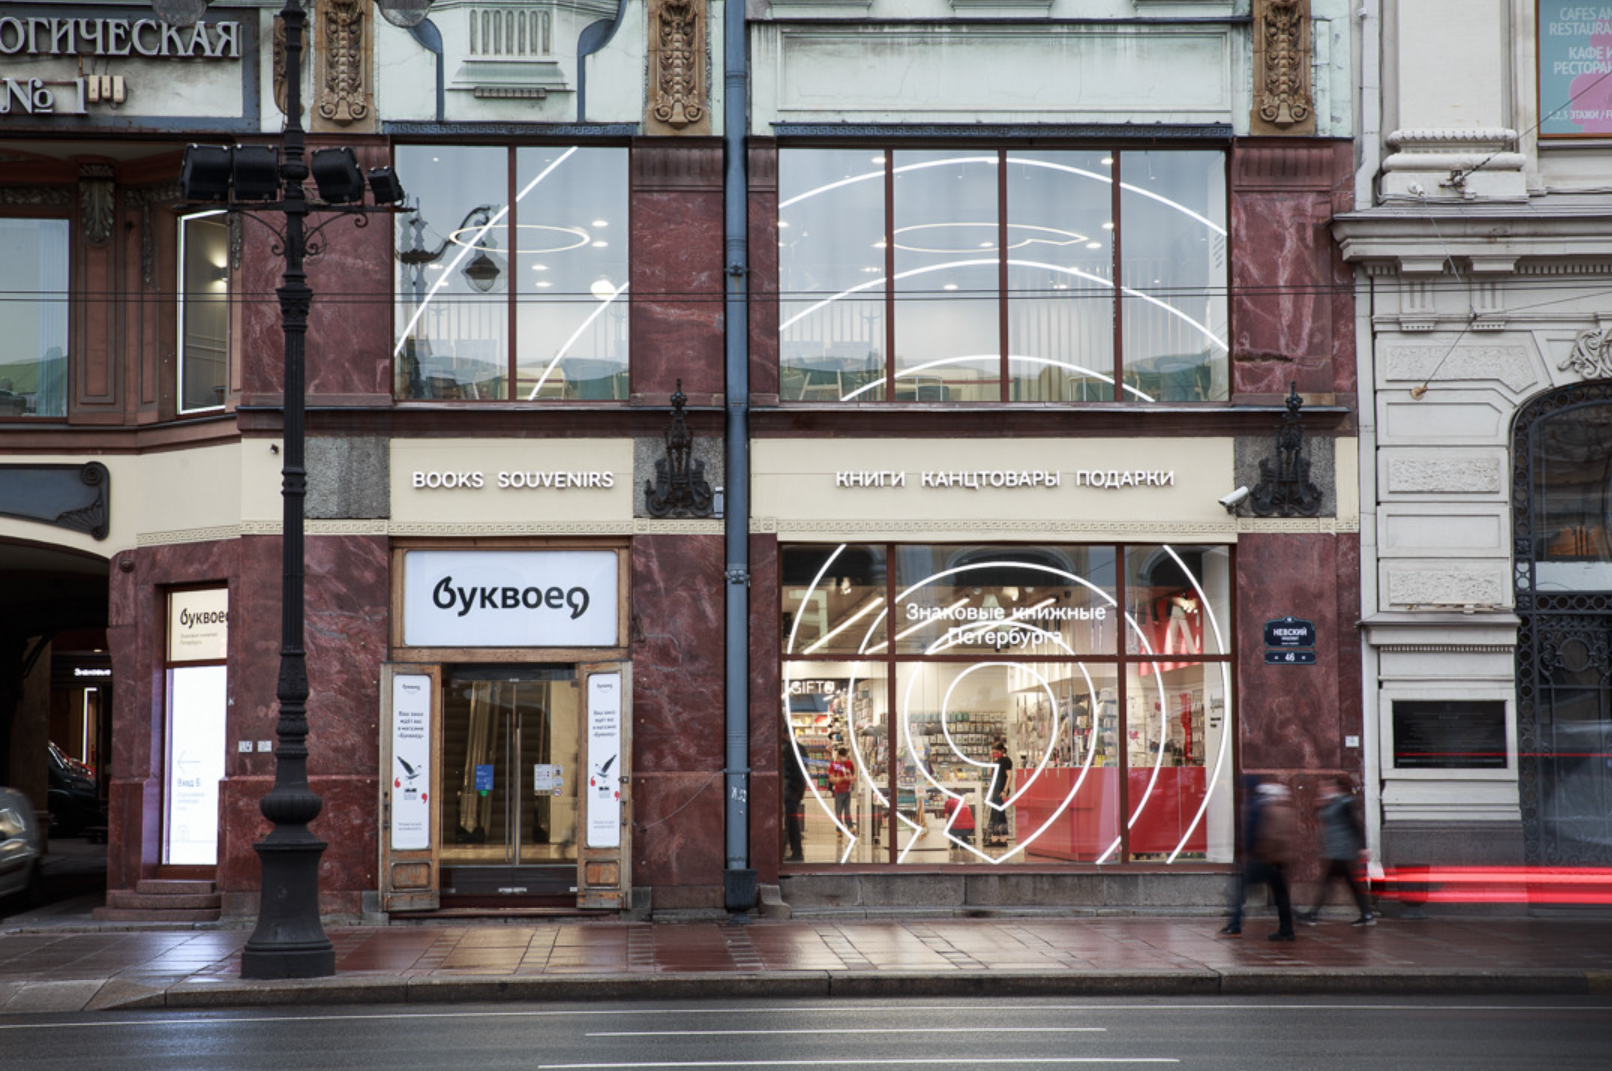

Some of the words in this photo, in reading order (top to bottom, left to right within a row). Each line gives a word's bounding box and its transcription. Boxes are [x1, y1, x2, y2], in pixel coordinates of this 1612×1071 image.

[1560, 7, 1597, 20] CAFES
[1549, 22, 1612, 36] RESTAURA
[1568, 46, 1604, 60] КАФЕ
[75, 77, 89, 114] 1
[412, 471, 484, 489] BOOKS
[497, 471, 614, 489] SOUVENIRS
[835, 471, 906, 488] КНИГИ
[921, 470, 1060, 490] КАНЦТОВАРЫ
[1076, 470, 1174, 489] ПОДАРКИ
[180, 608, 228, 629] буквое
[905, 602, 1005, 621] Знаковые
[1012, 605, 1107, 621] книжные
